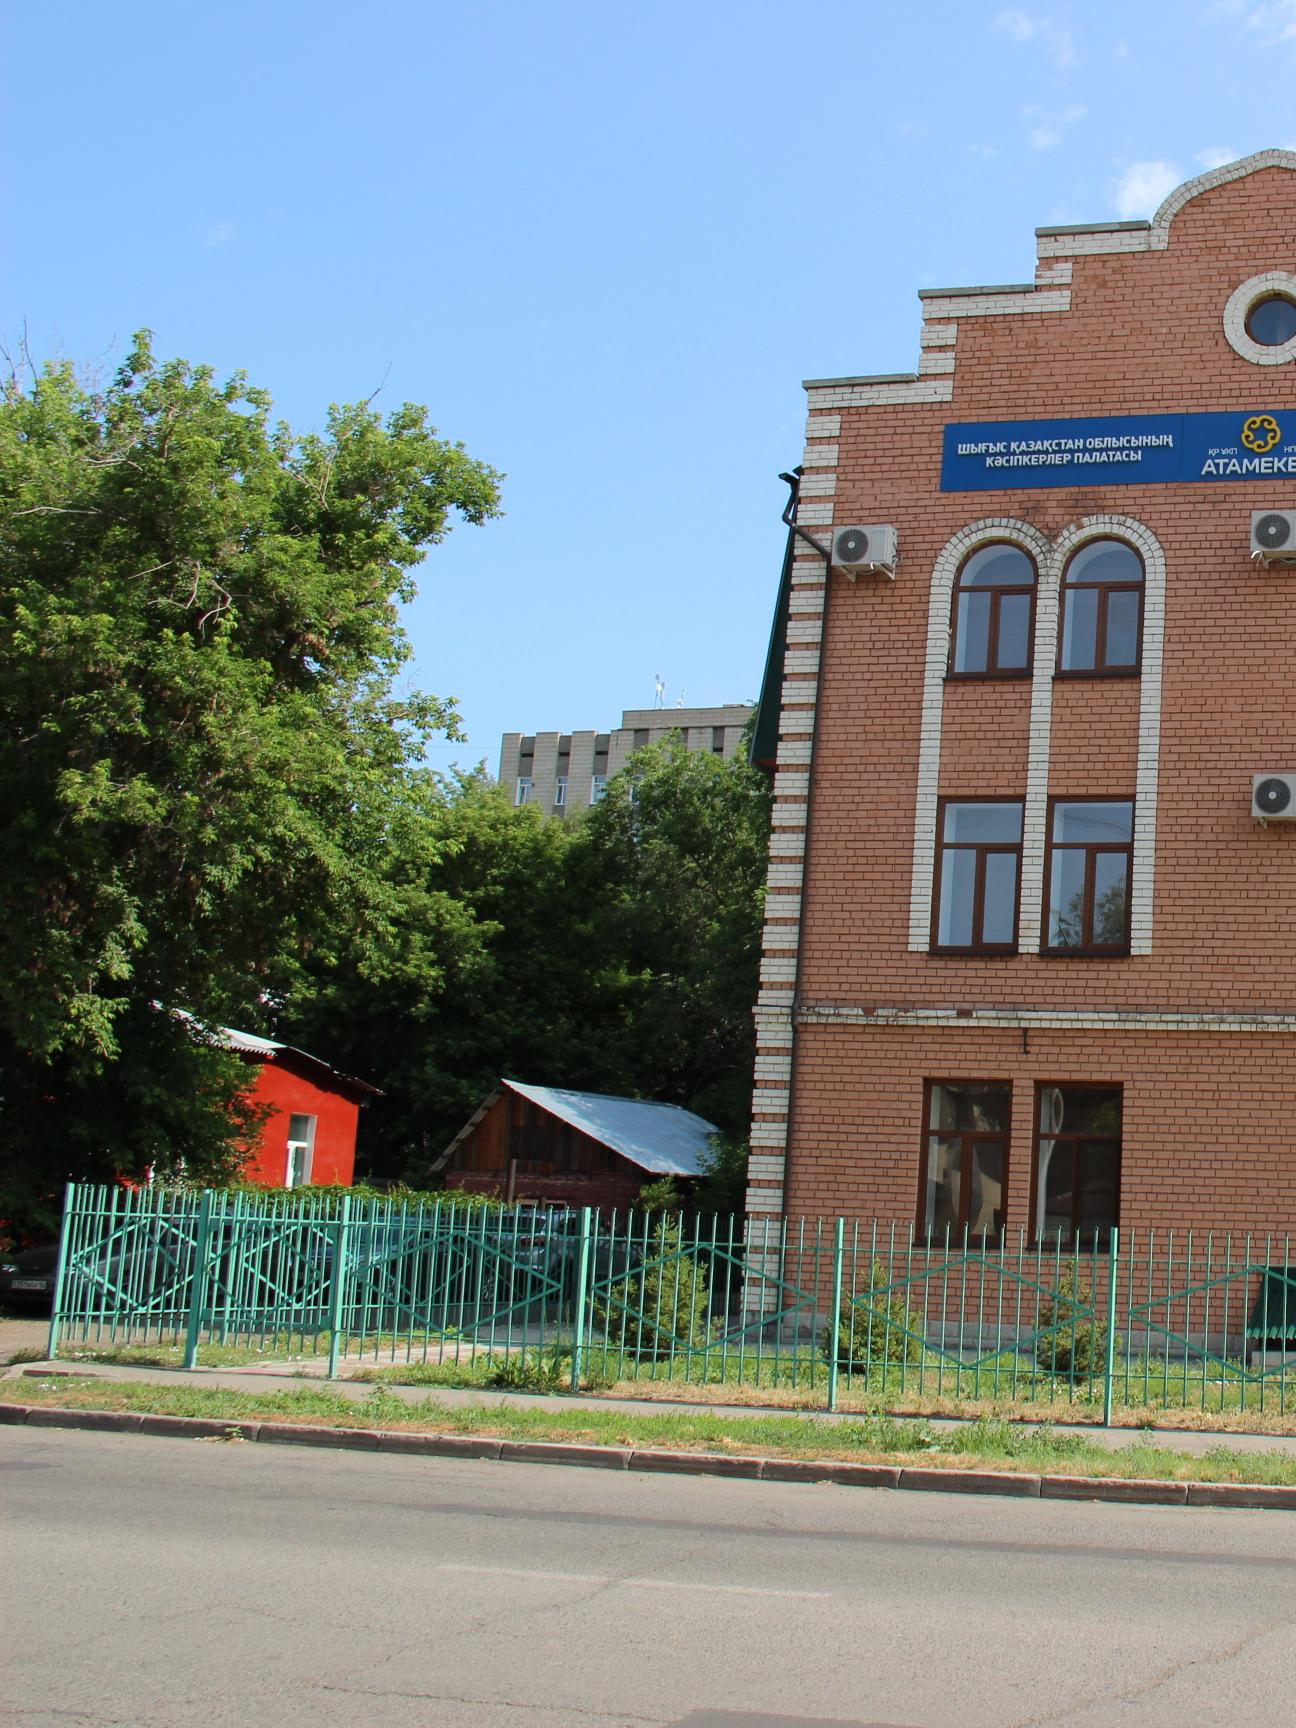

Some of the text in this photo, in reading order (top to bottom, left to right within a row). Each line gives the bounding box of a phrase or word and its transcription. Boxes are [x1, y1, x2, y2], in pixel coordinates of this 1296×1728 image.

[957, 434, 1174, 455] ШЫҒЫС ҚАЗАҚСТАН ОБЛЫСЫНЫҢ
[985, 450, 1142, 468] КӘСІПКЕРЛЕР ПАЛАТАСЫ
